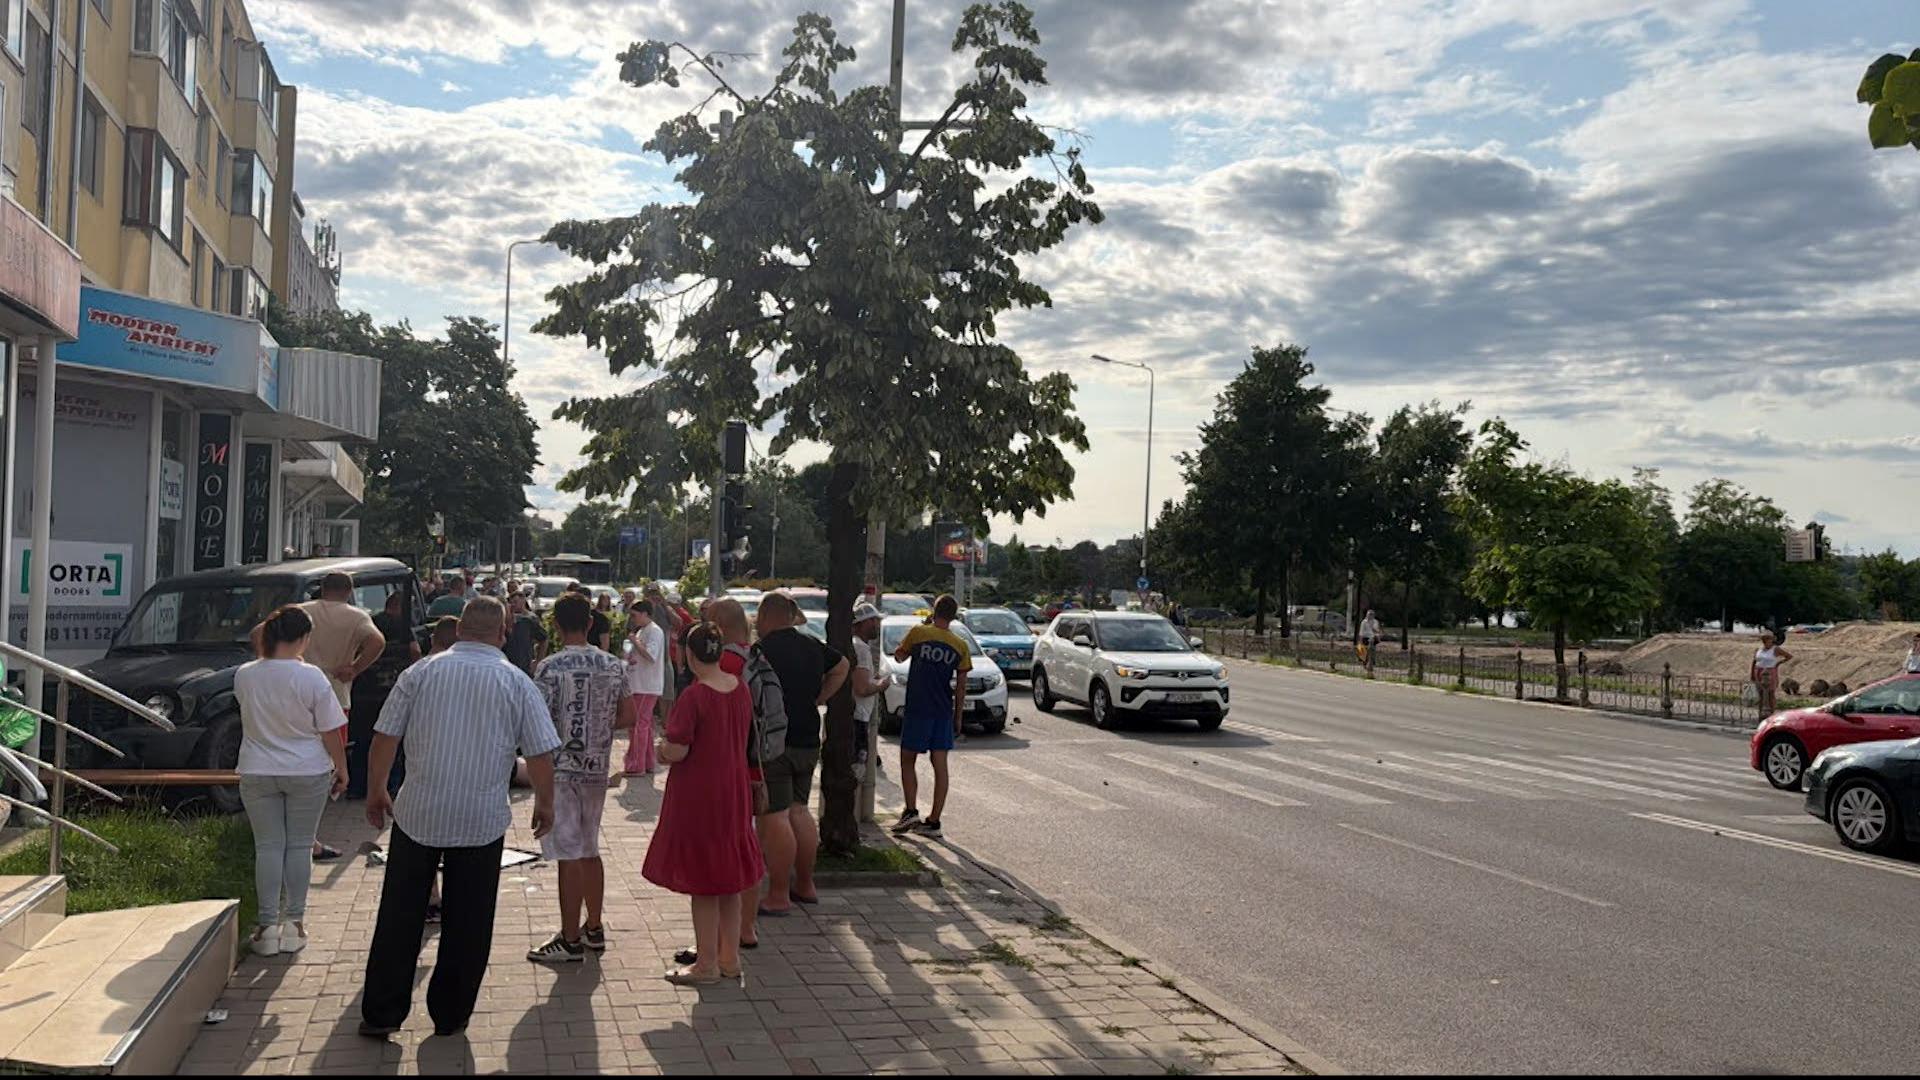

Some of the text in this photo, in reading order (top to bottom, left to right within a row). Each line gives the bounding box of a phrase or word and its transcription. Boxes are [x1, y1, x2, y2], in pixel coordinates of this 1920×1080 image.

[88, 308, 180, 336] MODERN
[126, 330, 219, 357] AMBIENT
[201, 442, 229, 559] MODE
[49, 564, 112, 584] ORTA
[54, 587, 90, 596] DOORS
[63, 627, 89, 640] 111
[920, 644, 957, 664] ROU
